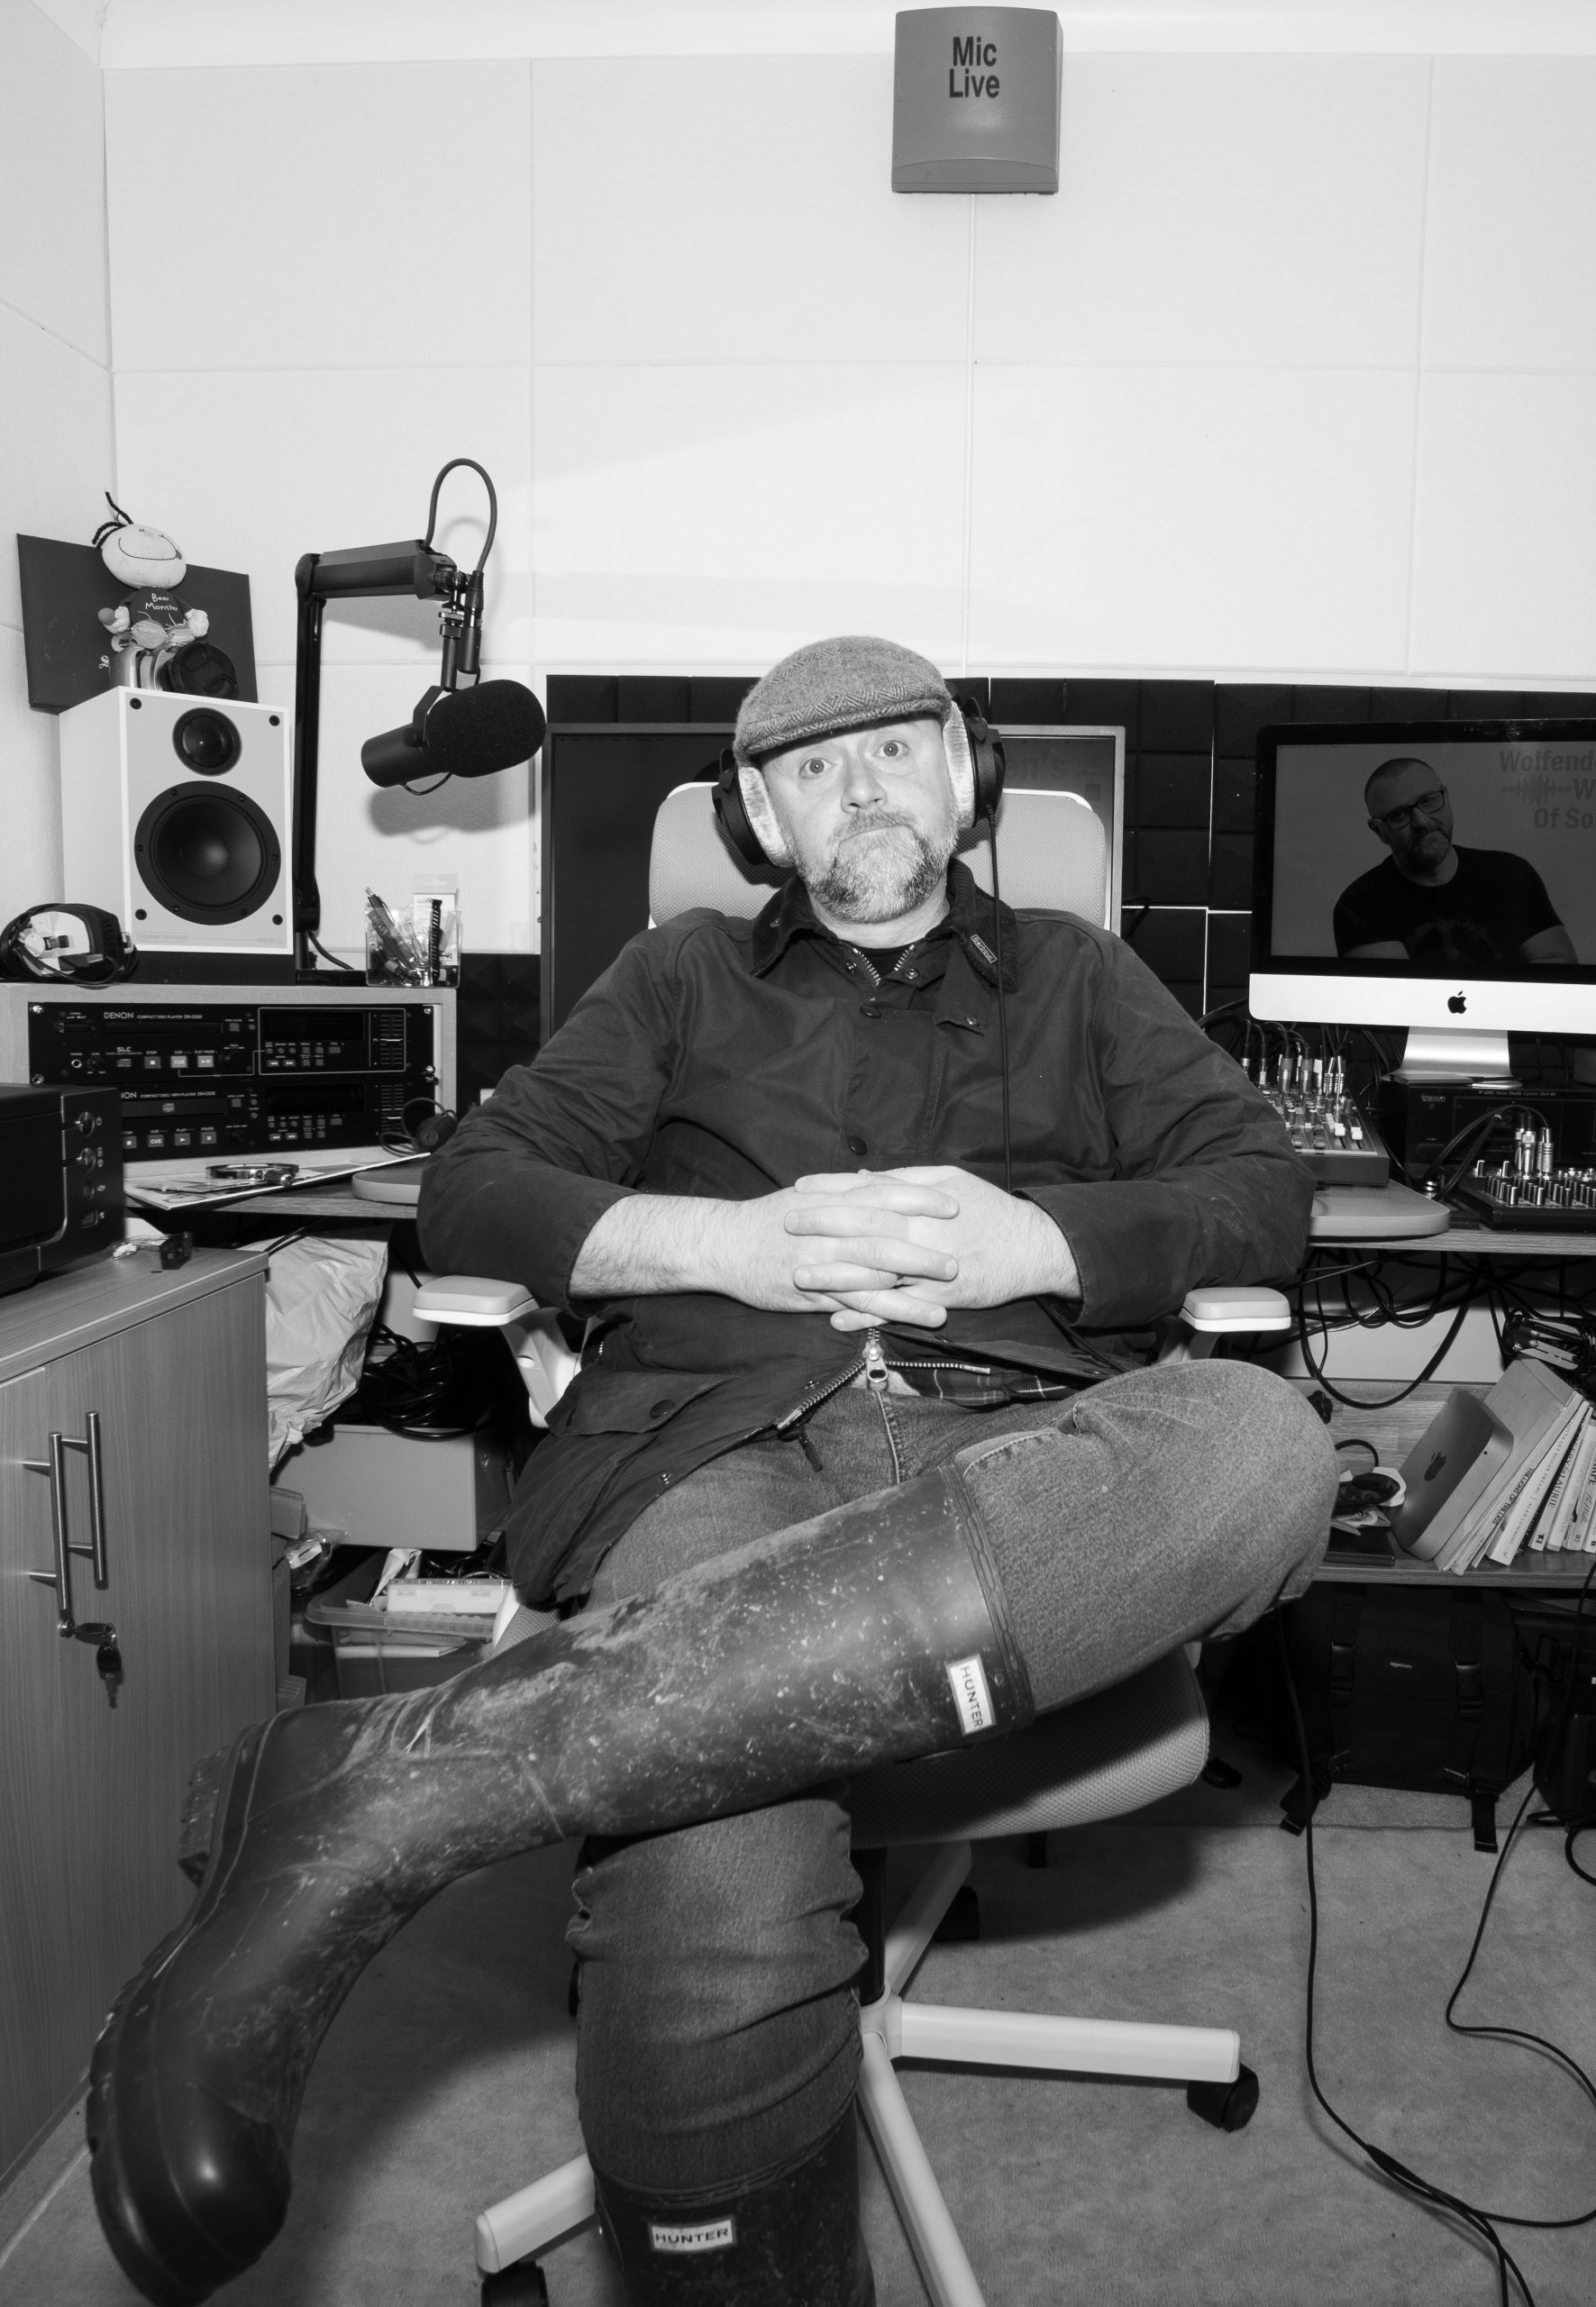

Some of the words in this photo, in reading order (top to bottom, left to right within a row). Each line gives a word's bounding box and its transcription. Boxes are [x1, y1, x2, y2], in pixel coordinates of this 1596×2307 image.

[953, 36, 997, 67] Mic
[949, 68, 1000, 98] Live
[145, 602, 178, 611] Monster
[151, 593, 169, 602] Beer
[1499, 750, 1596, 771] Wolfend
[1534, 807, 1560, 828] Of
[1565, 807, 1596, 828] So
[104, 1011, 134, 1019] DENON
[960, 1665, 983, 1728] HUNTER
[655, 2228, 729, 2244] HUNTER
